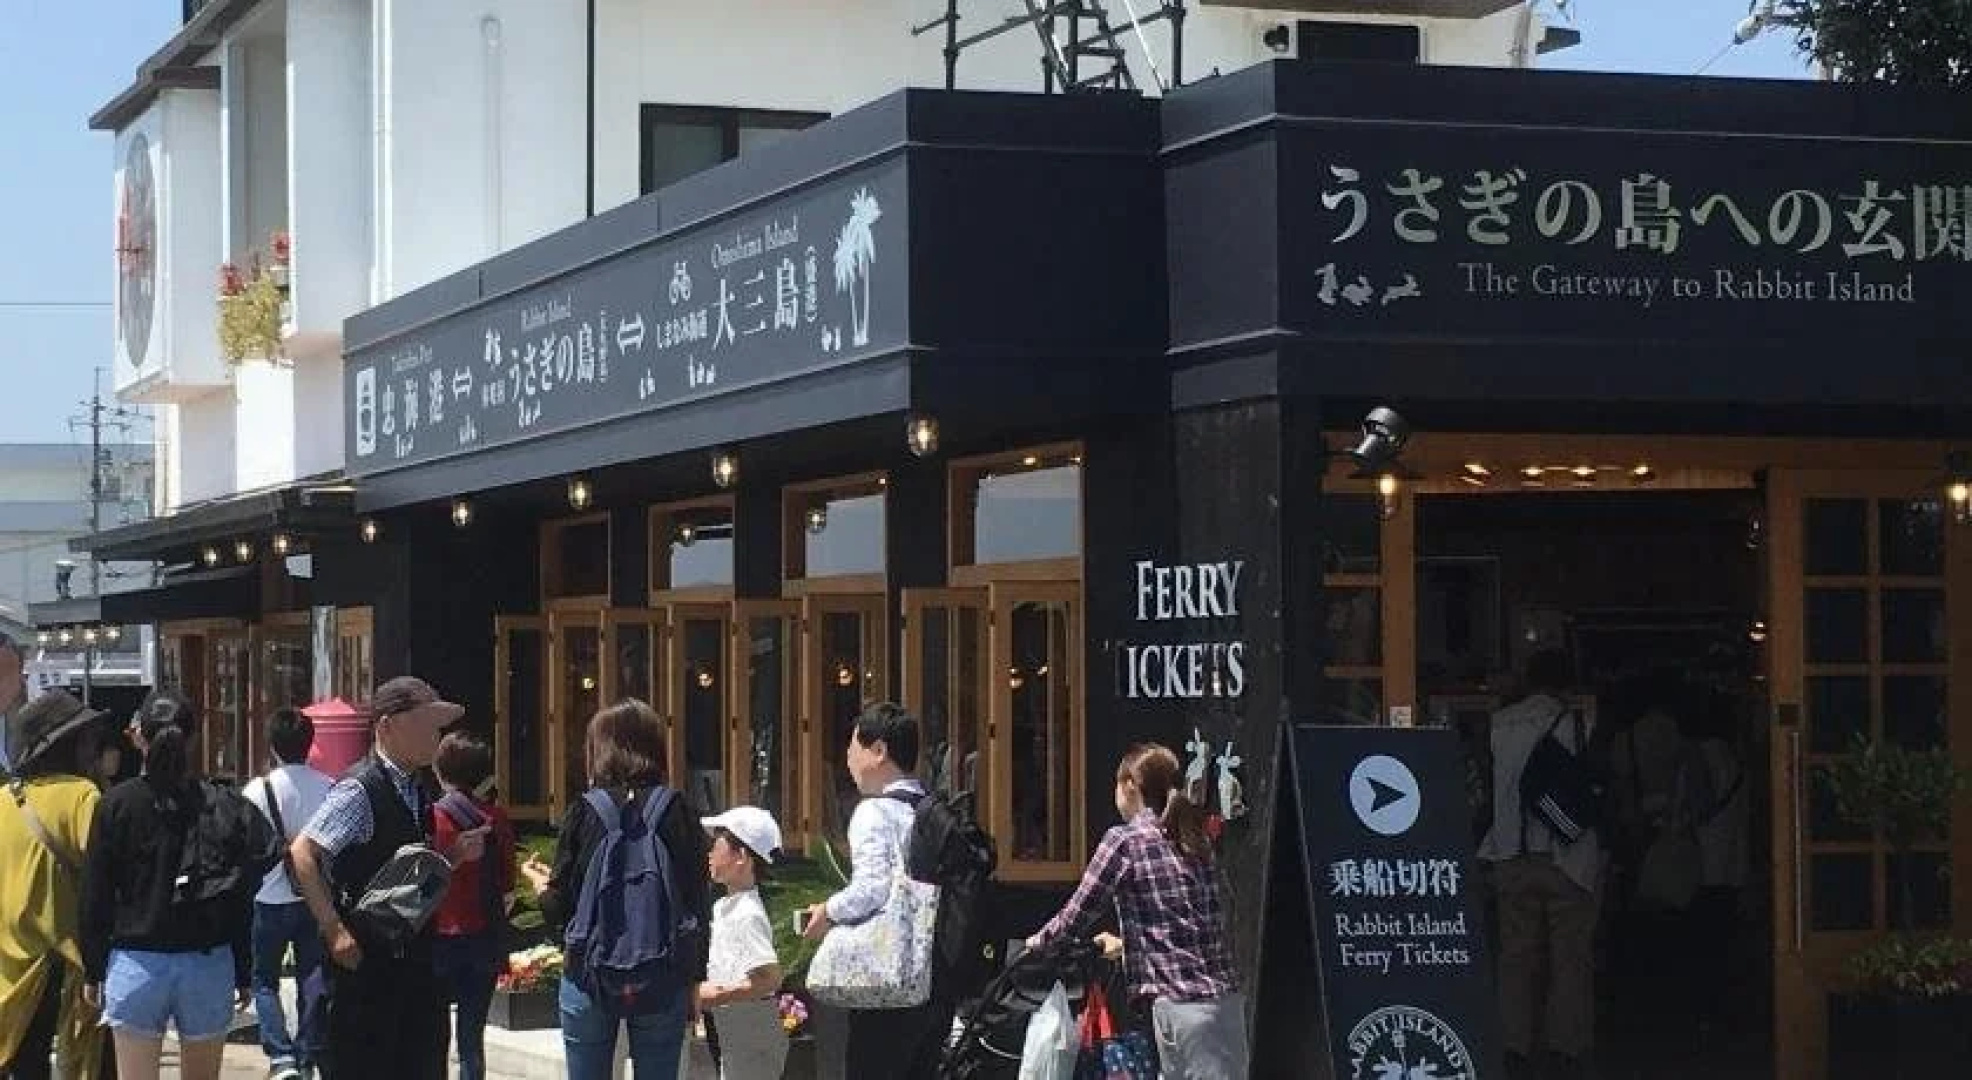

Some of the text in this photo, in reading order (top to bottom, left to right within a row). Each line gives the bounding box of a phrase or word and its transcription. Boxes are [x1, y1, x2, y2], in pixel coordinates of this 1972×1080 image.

[1321, 165, 1972, 263] うさぎの島への玄関
[711, 257, 800, 350] 大三島
[1457, 262, 1914, 307] The Gateway to Rabbit Island
[508, 322, 595, 403] うさぎの島
[1135, 560, 1245, 621] FERRY
[1105, 640, 1245, 698] ICKETS
[1328, 858, 1461, 897] 乗船切符
[1335, 911, 1467, 936] Rabbit Island
[1340, 941, 1470, 974] Ferry Tickets
[1399, 1013, 1462, 1070] ISLAND
